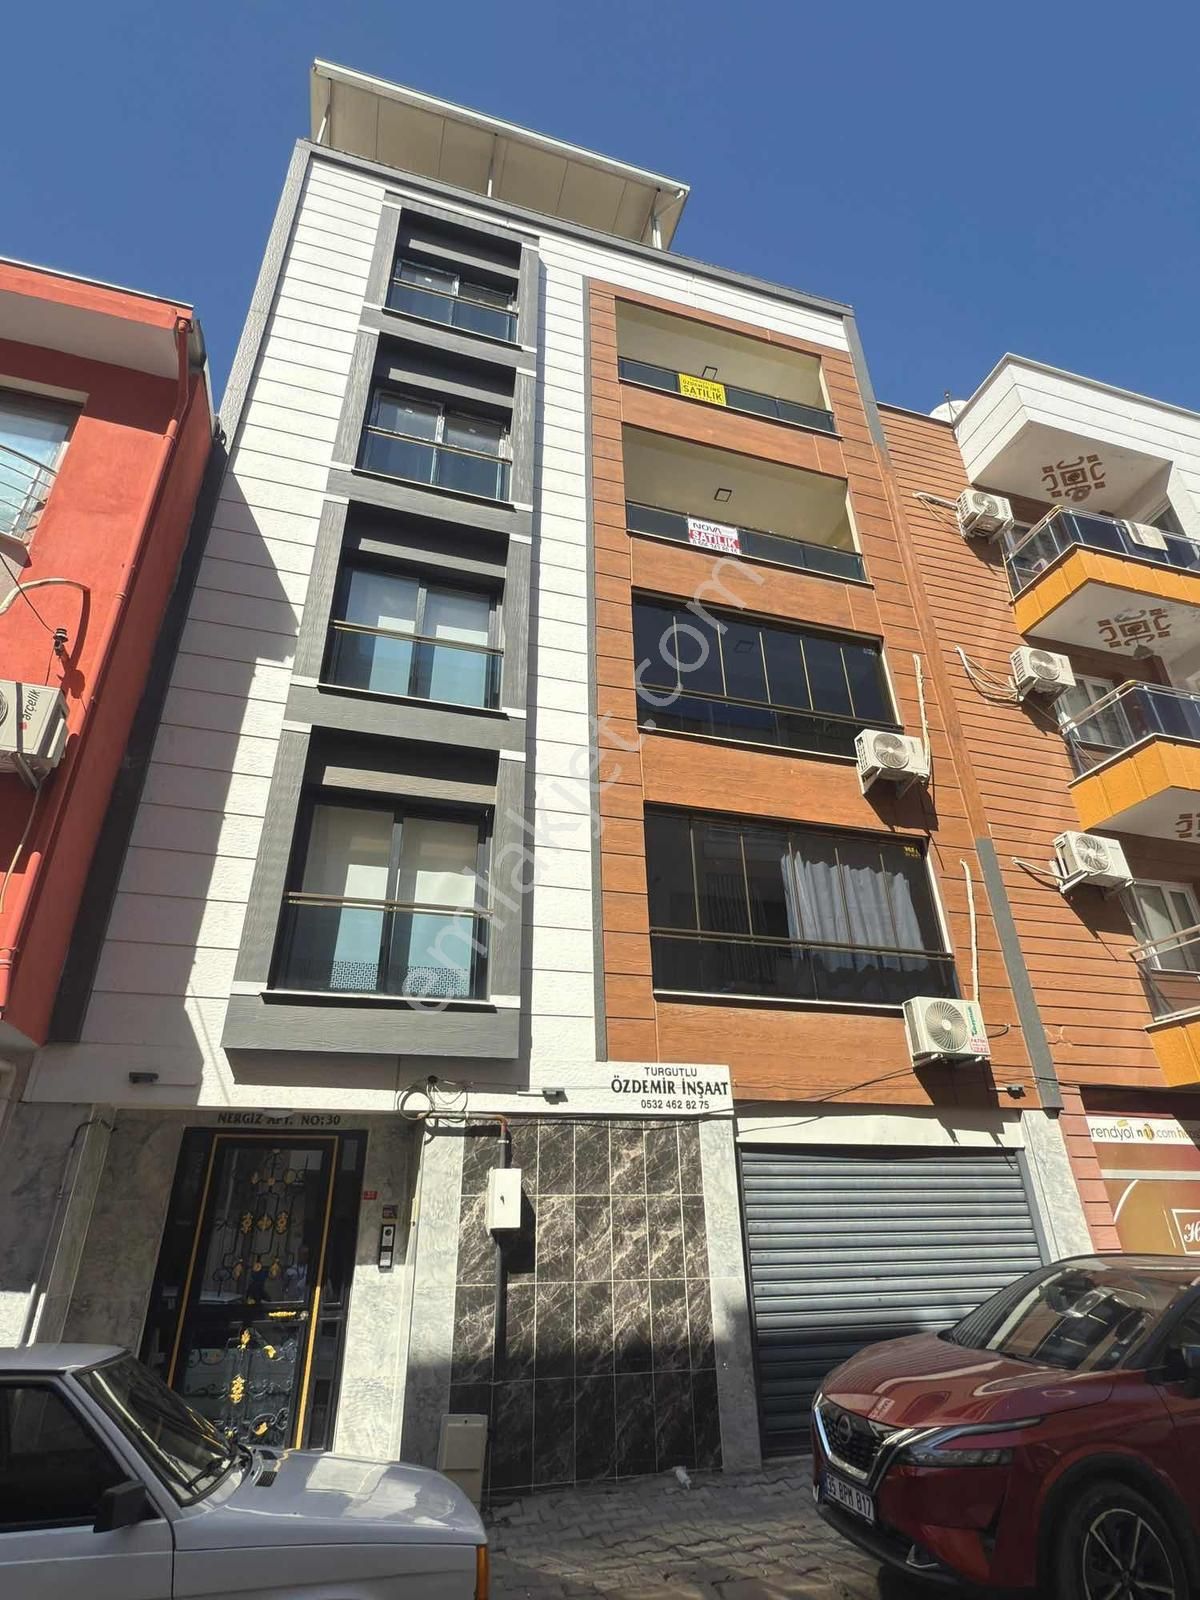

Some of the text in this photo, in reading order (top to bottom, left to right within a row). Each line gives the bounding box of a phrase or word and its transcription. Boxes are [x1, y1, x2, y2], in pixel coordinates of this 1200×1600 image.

[692, 522, 722, 534] NOVA
[22, 689, 40, 720] arçelik
[644, 1066, 697, 1077] TURGUTLU
[611, 1075, 728, 1098] ÖZDEMİR İNŞAAT
[641, 1099, 709, 1109] 0532 462 82 75
[1091, 1126, 1134, 1141] rendyol
